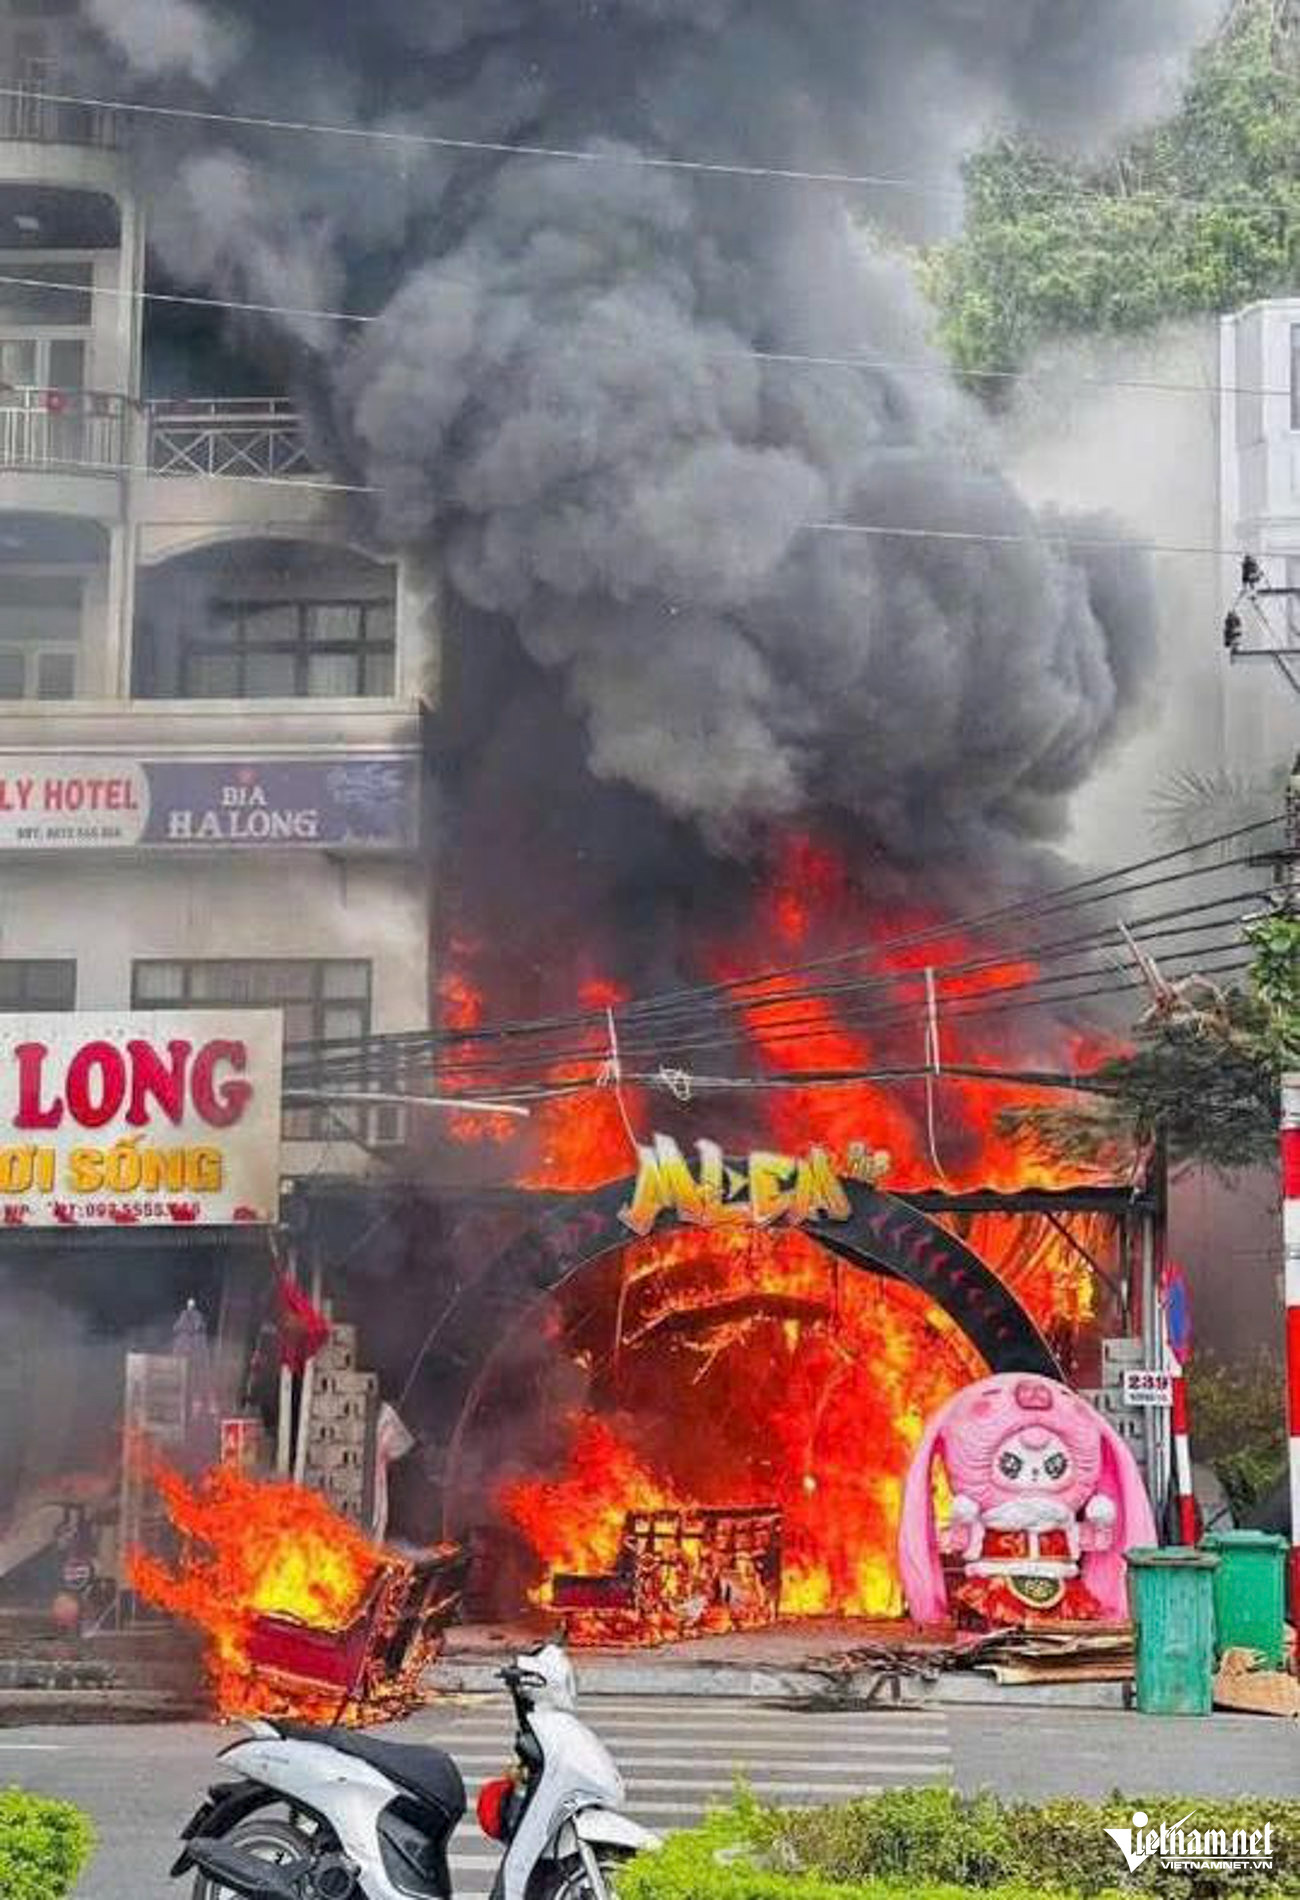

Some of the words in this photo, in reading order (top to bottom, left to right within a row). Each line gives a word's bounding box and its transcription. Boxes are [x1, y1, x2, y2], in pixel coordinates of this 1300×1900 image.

[44, 779, 139, 810] HOTEL
[13, 1039, 253, 1129] LONG
[70, 1133, 222, 1193] SỐNG
